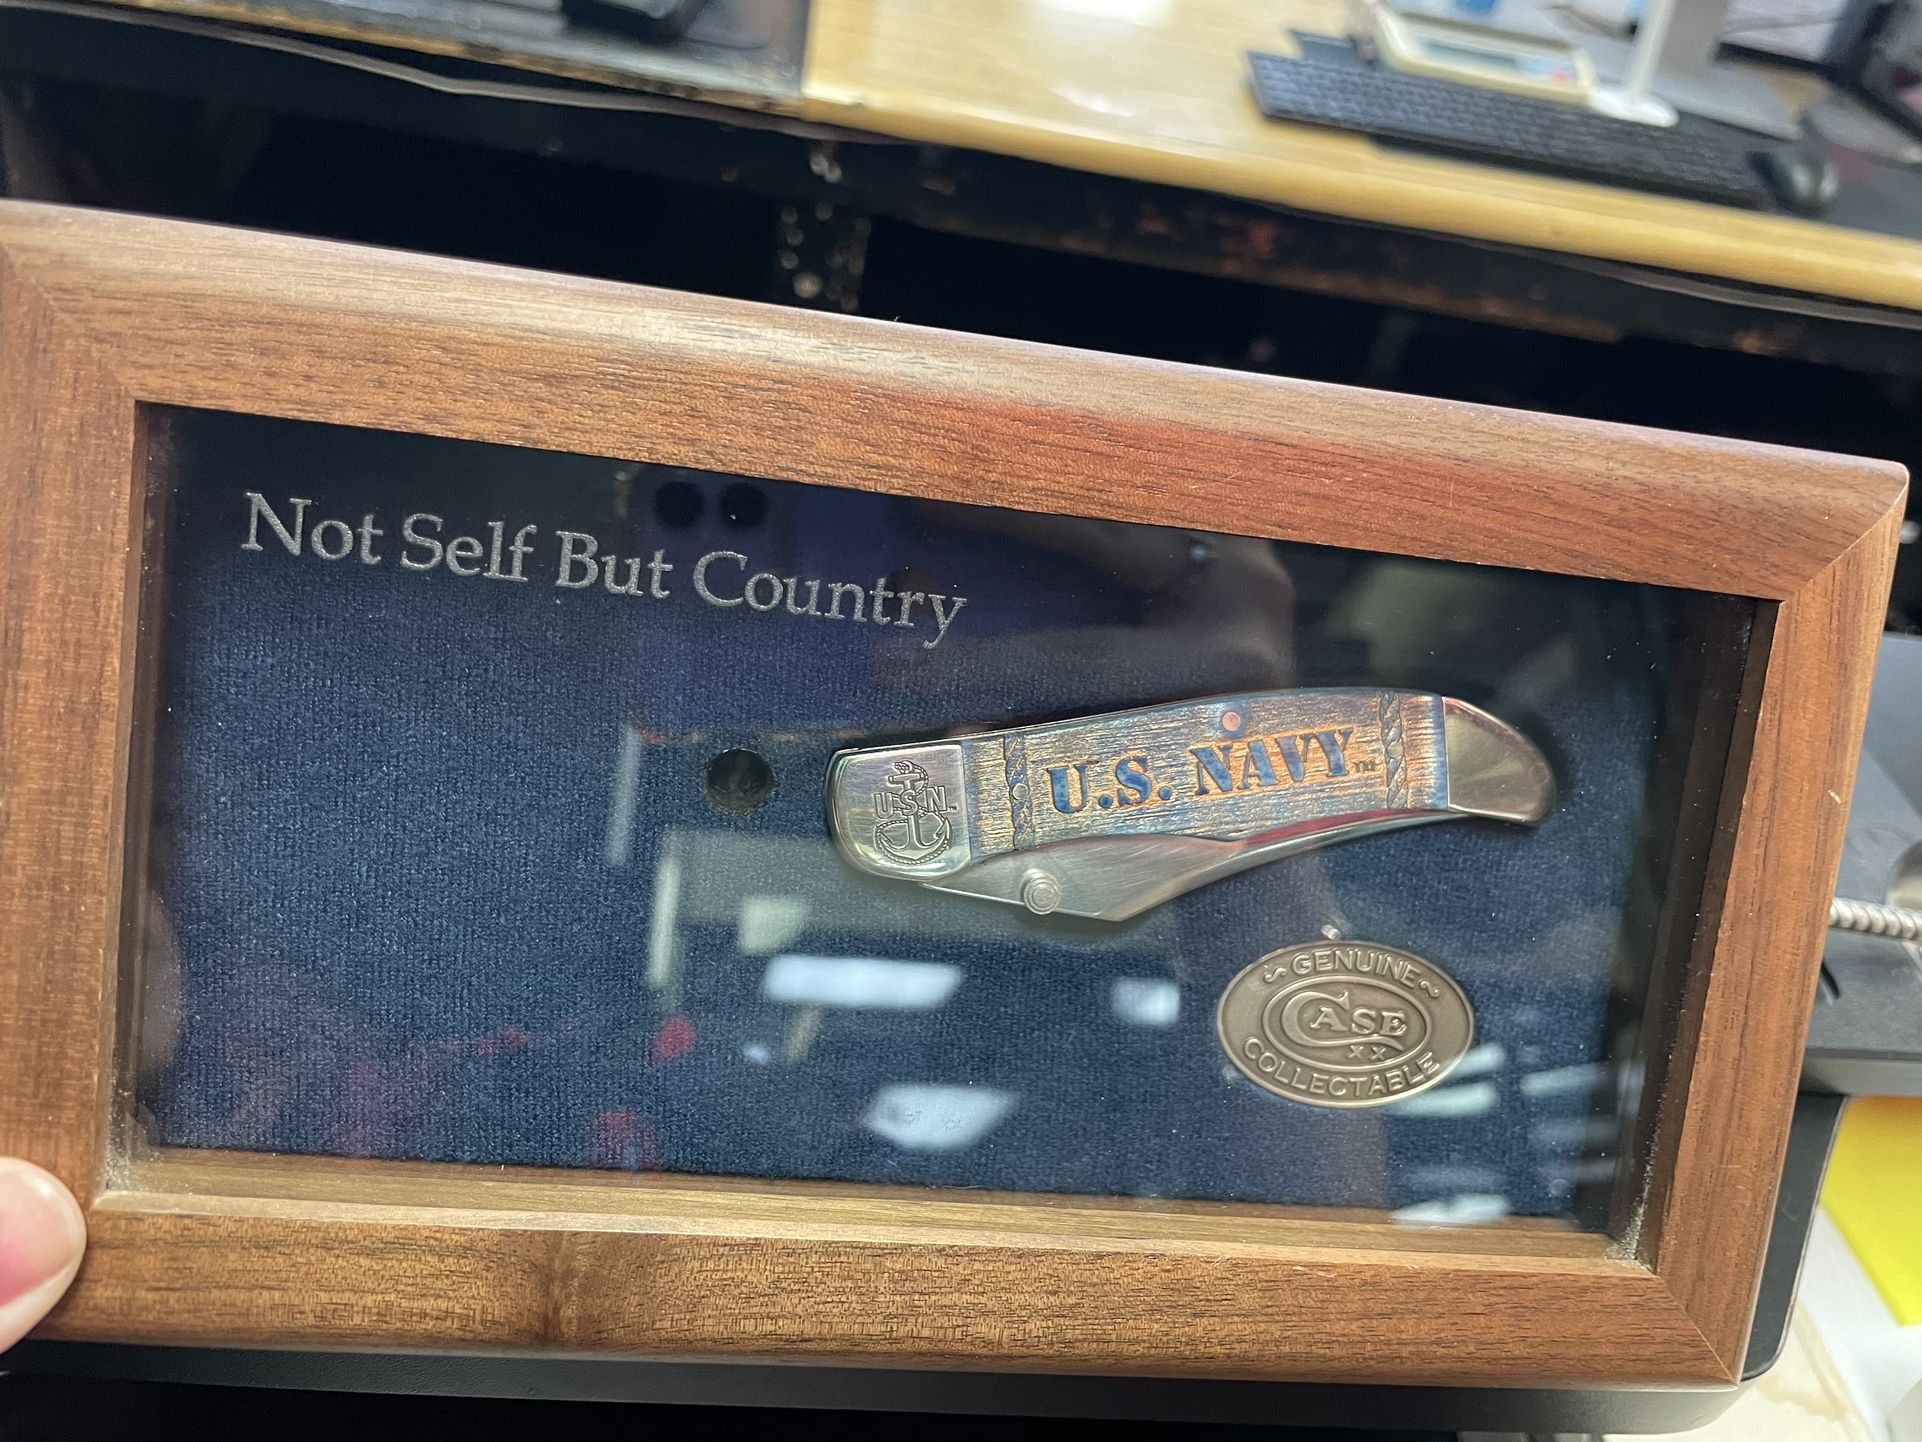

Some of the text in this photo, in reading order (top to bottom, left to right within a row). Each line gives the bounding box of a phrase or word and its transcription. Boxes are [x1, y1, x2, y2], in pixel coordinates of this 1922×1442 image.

[240, 491, 967, 650] Not Self But Country
[1047, 756, 1172, 814] U.S.
[1191, 728, 1354, 796] NAVY
[873, 785, 947, 820] USN
[1292, 949, 1422, 988] GENUINE
[1281, 990, 1407, 1050] CASE
[1243, 1036, 1440, 1098] COLLECTABLE
